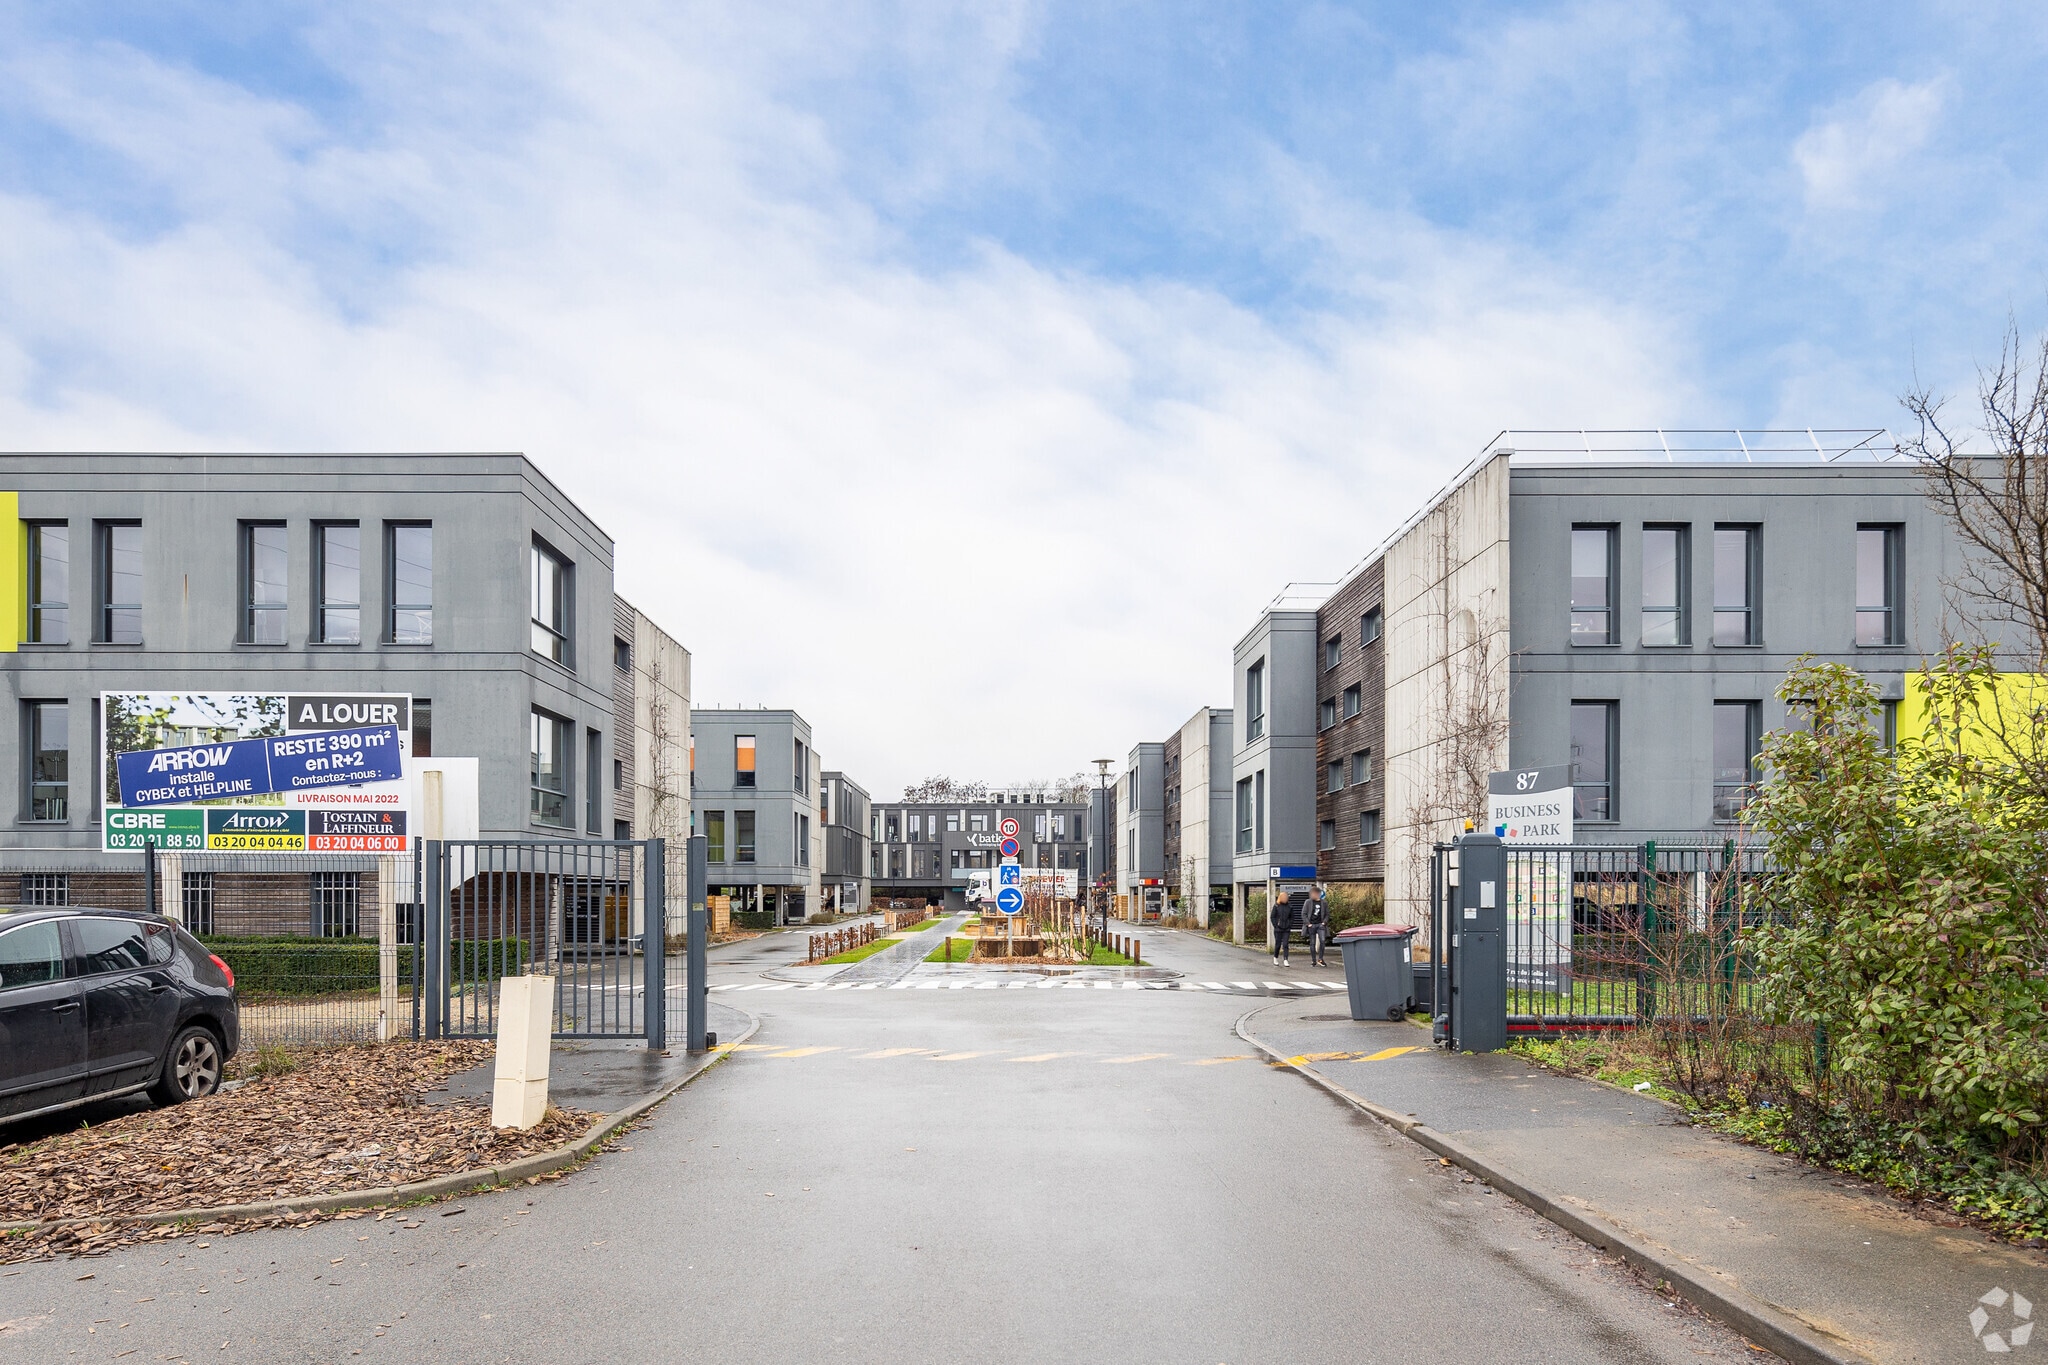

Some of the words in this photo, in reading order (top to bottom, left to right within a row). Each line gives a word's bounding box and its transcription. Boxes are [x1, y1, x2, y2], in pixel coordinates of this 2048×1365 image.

[299, 704, 317, 722] A
[322, 704, 398, 724] LOUER
[274, 737, 326, 757] RESTE
[329, 733, 362, 750] 390
[147, 746, 233, 773] ARROW
[305, 756, 329, 771] en
[331, 751, 364, 769] R+2
[169, 771, 215, 785] installe
[292, 770, 376, 786] Contactez-nous
[1516, 771, 1539, 790] 87
[136, 787, 176, 802] CYBEX
[178, 787, 192, 797] et
[194, 779, 253, 796] HELPLINE
[297, 794, 351, 803] LIVRAISON
[353, 794, 373, 803] MAI
[375, 794, 399, 803] 2022
[320, 812, 377, 823] TOSTAIN
[382, 813, 392, 823] &
[1495, 803, 1560, 819] BUSINESS
[109, 813, 166, 829] CBRE
[223, 812, 290, 828] Arrow
[1523, 823, 1560, 836] PARK
[110, 834, 126, 847] 03
[129, 834, 145, 847] 20
[166, 834, 183, 847] 88
[185, 834, 201, 847] 50
[214, 837, 228, 847] 03
[232, 837, 246, 847] 20
[249, 837, 264, 847] 04
[268, 837, 283, 847] 04
[286, 837, 302, 848] 46
[316, 837, 330, 849] 03
[333, 837, 347, 849] 20
[350, 837, 364, 849] 04
[367, 837, 381, 849] 06
[384, 837, 399, 849] 00
